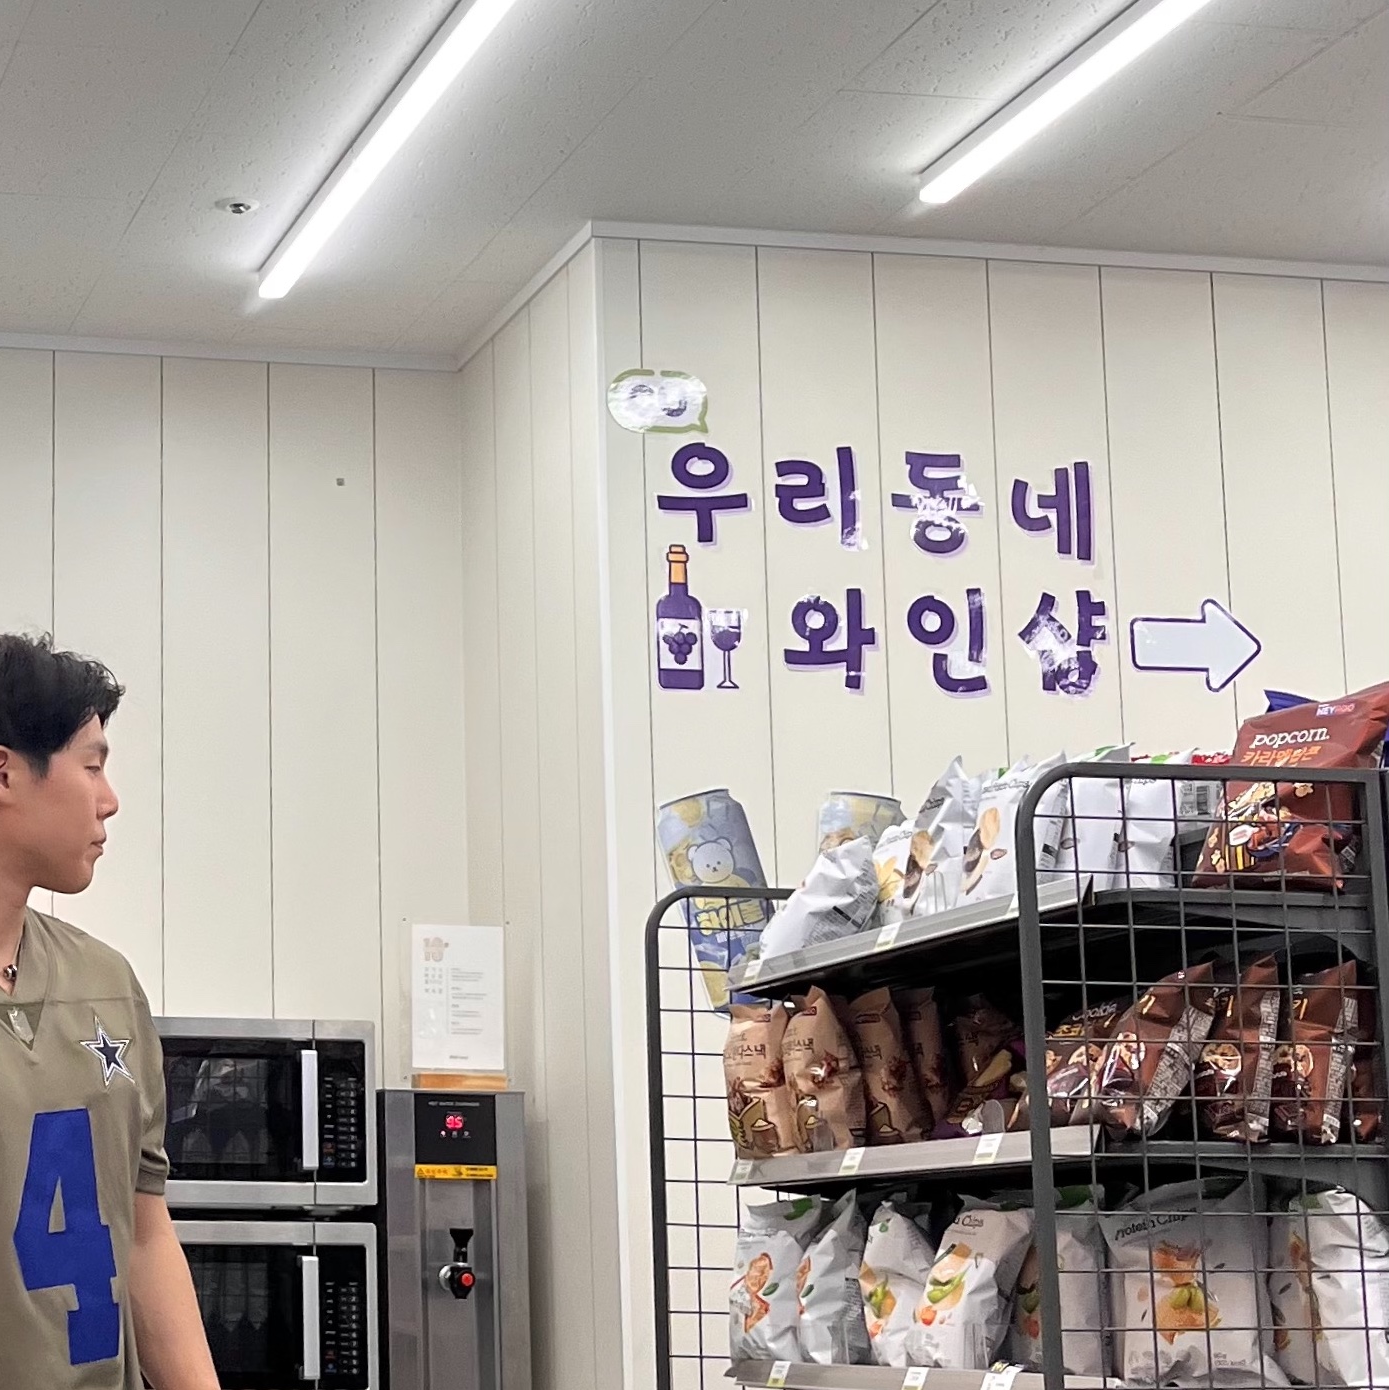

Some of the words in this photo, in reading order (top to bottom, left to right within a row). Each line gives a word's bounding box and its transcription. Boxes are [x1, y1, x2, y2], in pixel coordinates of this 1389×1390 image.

[656, 442, 1092, 561] 우리동네
[445, 1115, 463, 1129] 95
[14, 1107, 120, 1365] 4
